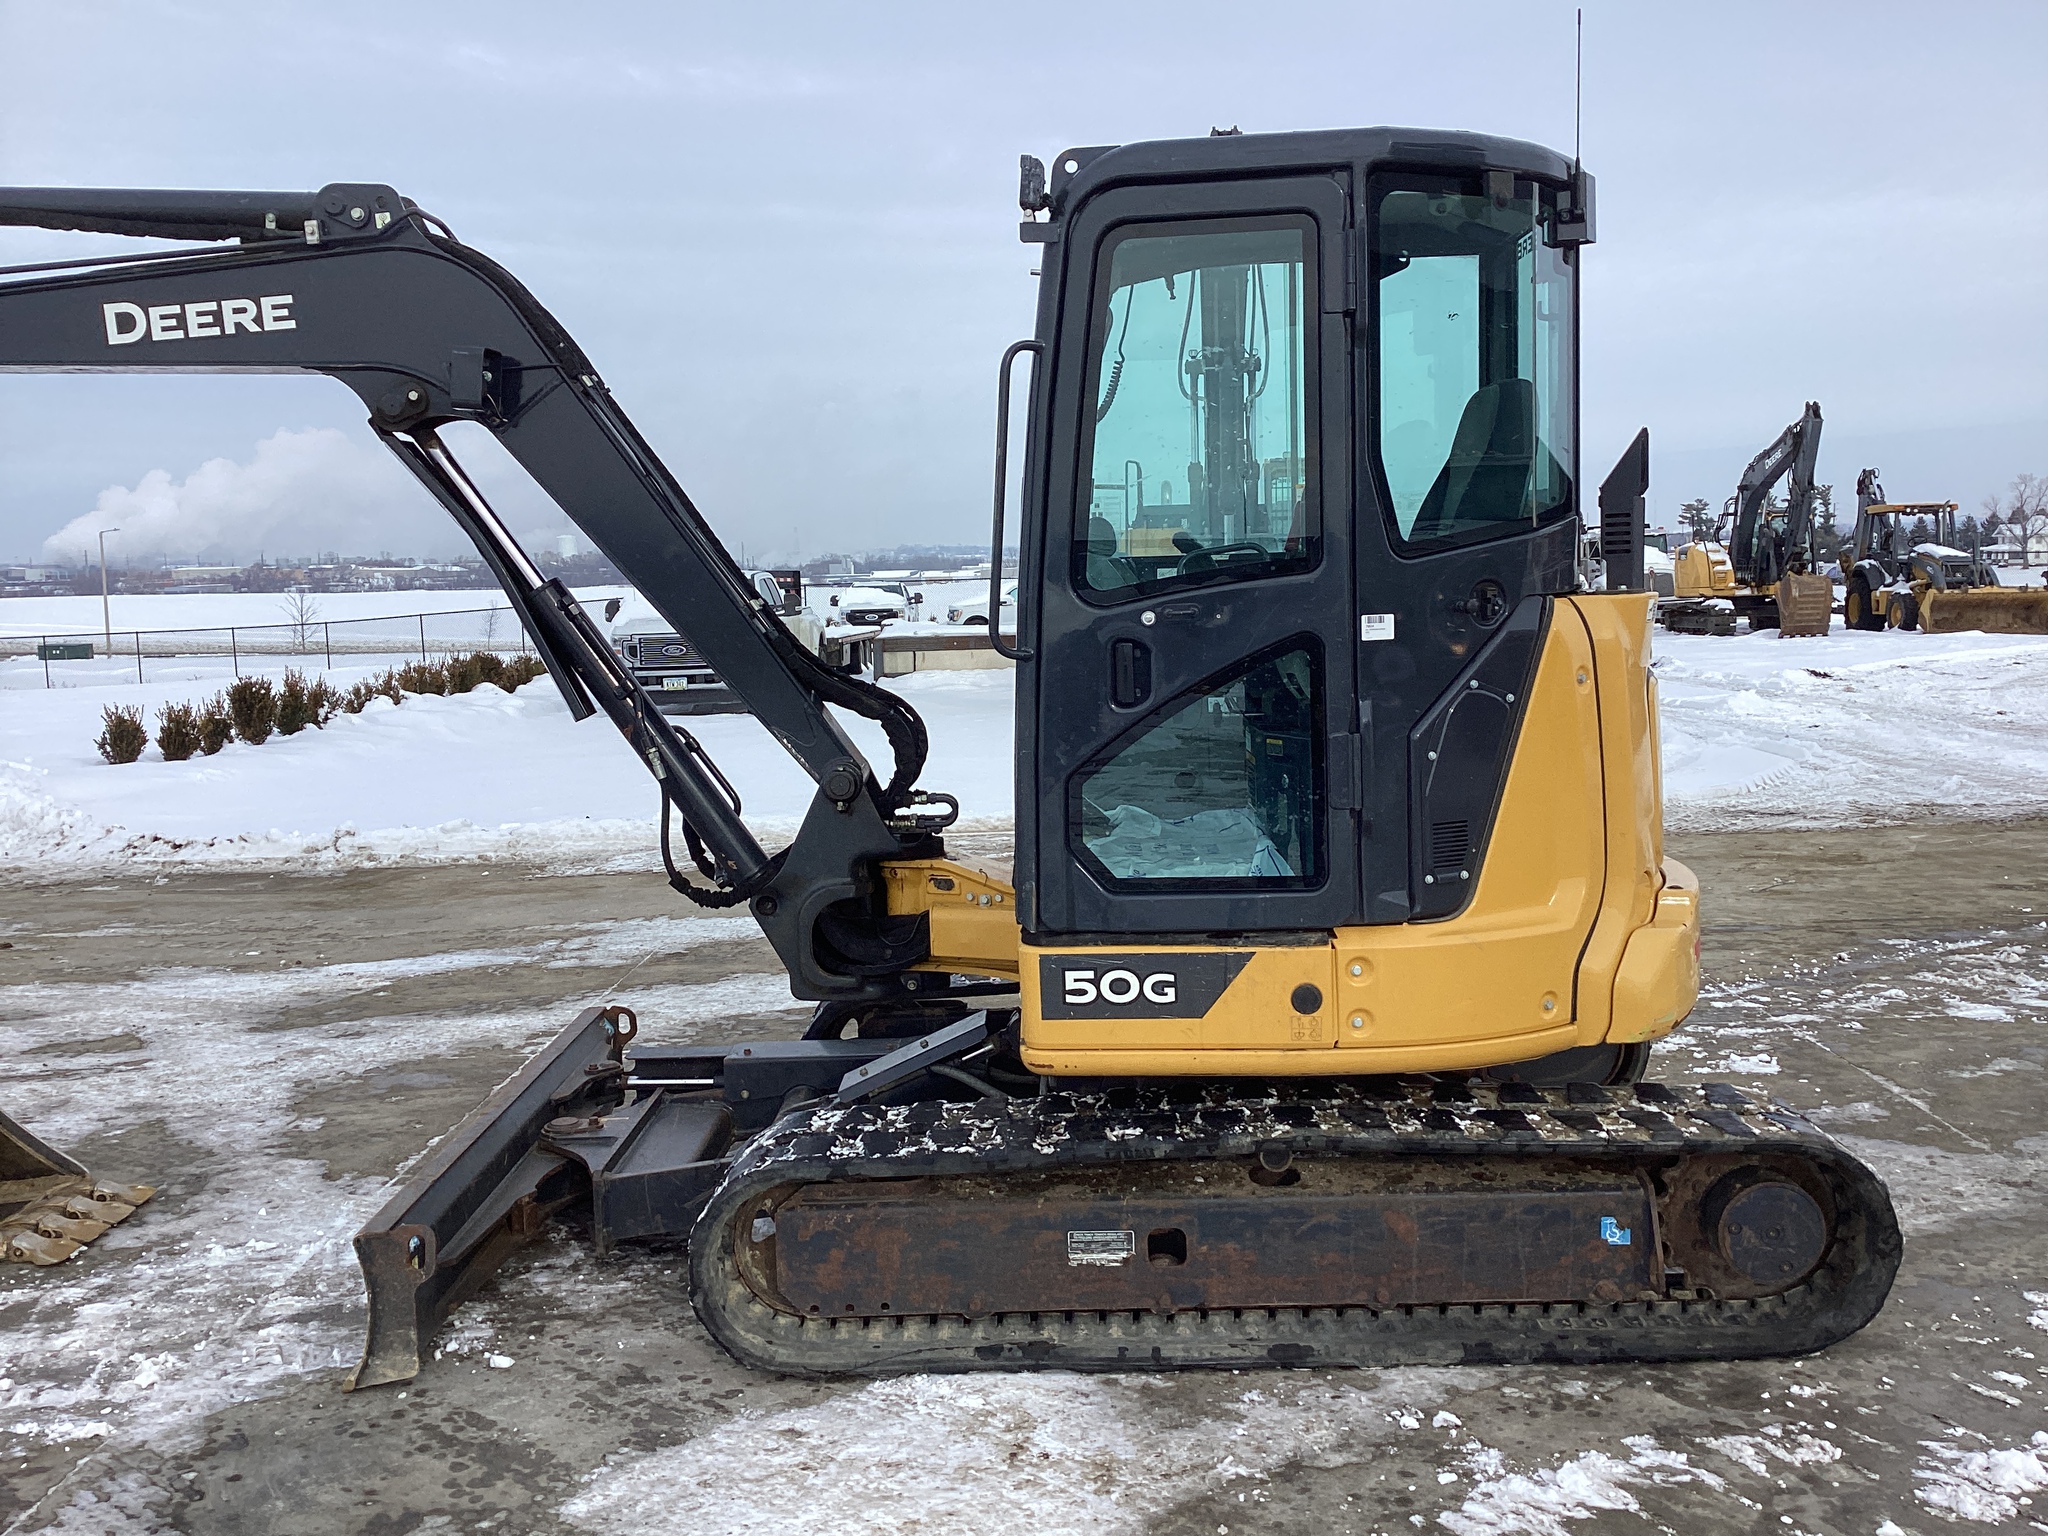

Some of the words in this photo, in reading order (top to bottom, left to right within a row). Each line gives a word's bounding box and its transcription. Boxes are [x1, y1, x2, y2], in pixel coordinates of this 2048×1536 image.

[103, 294, 297, 345] DEERE
[1765, 448, 1782, 470] DEERE
[1064, 969, 1177, 1004] 50G
